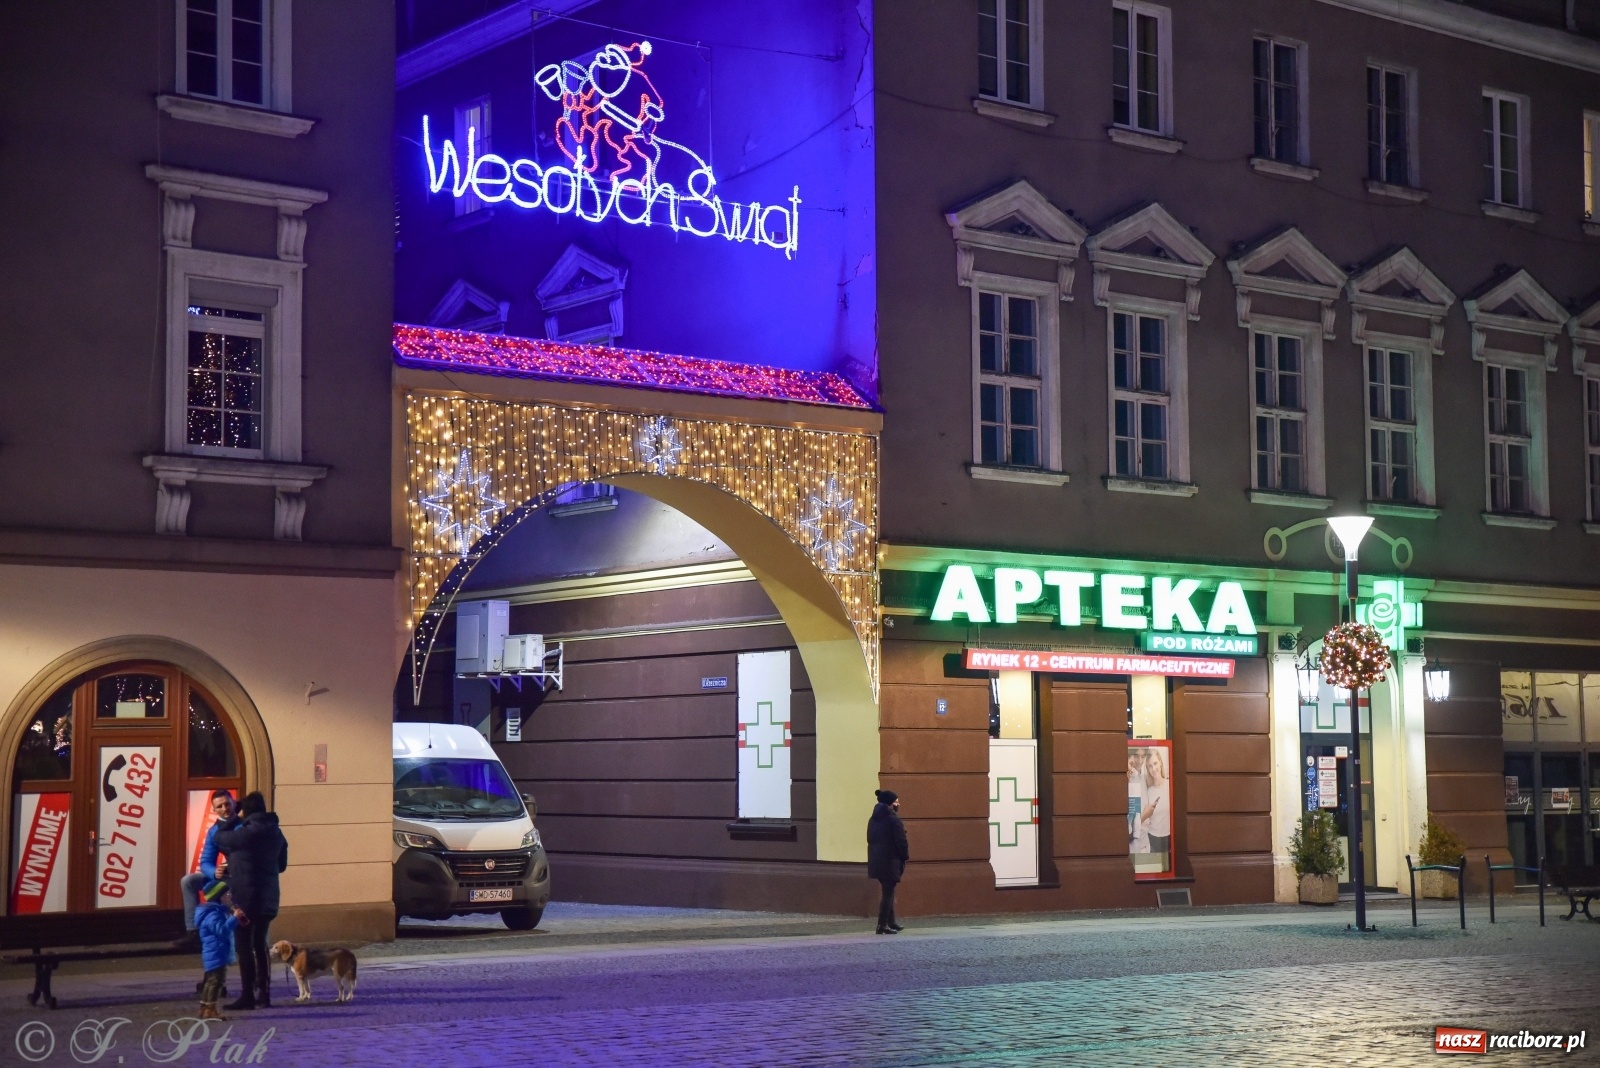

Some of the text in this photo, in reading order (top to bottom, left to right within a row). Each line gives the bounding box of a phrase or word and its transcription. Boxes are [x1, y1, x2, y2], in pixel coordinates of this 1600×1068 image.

[930, 564, 1258, 635] APTEKA
[972, 654, 1020, 668] RYNEK
[1023, 655, 1040, 668] 12
[1049, 656, 1114, 671] CENTRUM
[1116, 659, 1230, 675] FARMACEUTYCZNE
[1153, 636, 1254, 653] POD RÓŻAMI
[99, 752, 157, 899] 602 716 432
[18, 807, 68, 897] WYNAJMĘ
[489, 889, 511, 898] 57460
